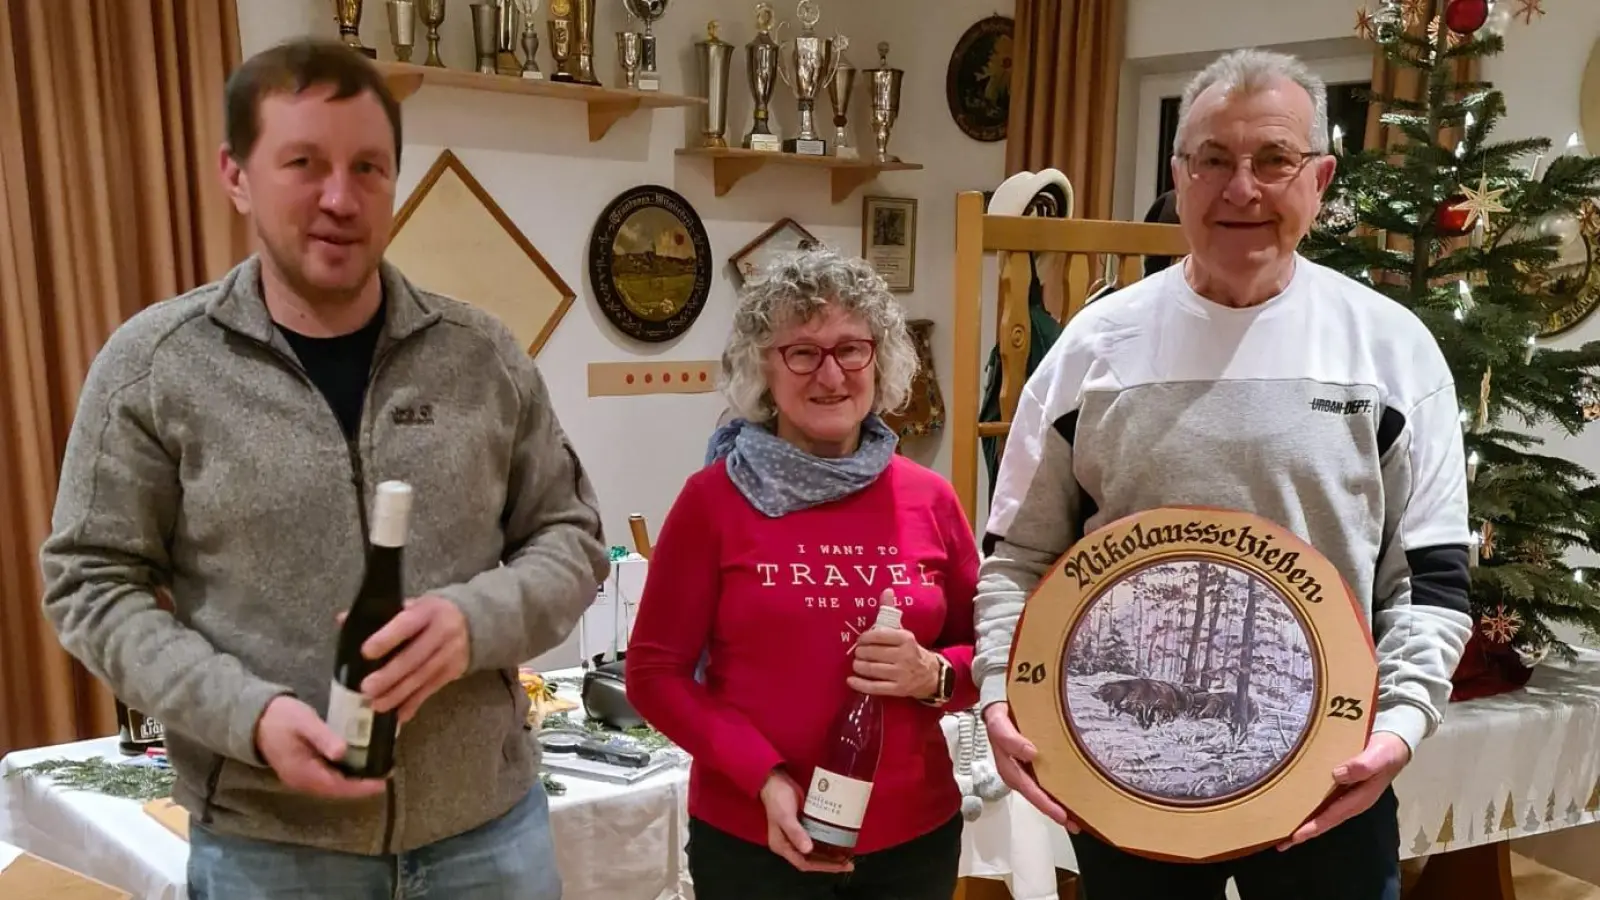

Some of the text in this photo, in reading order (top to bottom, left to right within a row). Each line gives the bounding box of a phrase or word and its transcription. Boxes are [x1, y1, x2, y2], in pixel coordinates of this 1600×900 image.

[798, 544, 898, 556] I WANT TO
[757, 563, 935, 587] TRAVEL
[805, 596, 914, 609] THE WOLD
[857, 617, 867, 627] N
[841, 632, 850, 642] W
[1015, 661, 1047, 684] 20
[1327, 695, 1364, 721] 23
